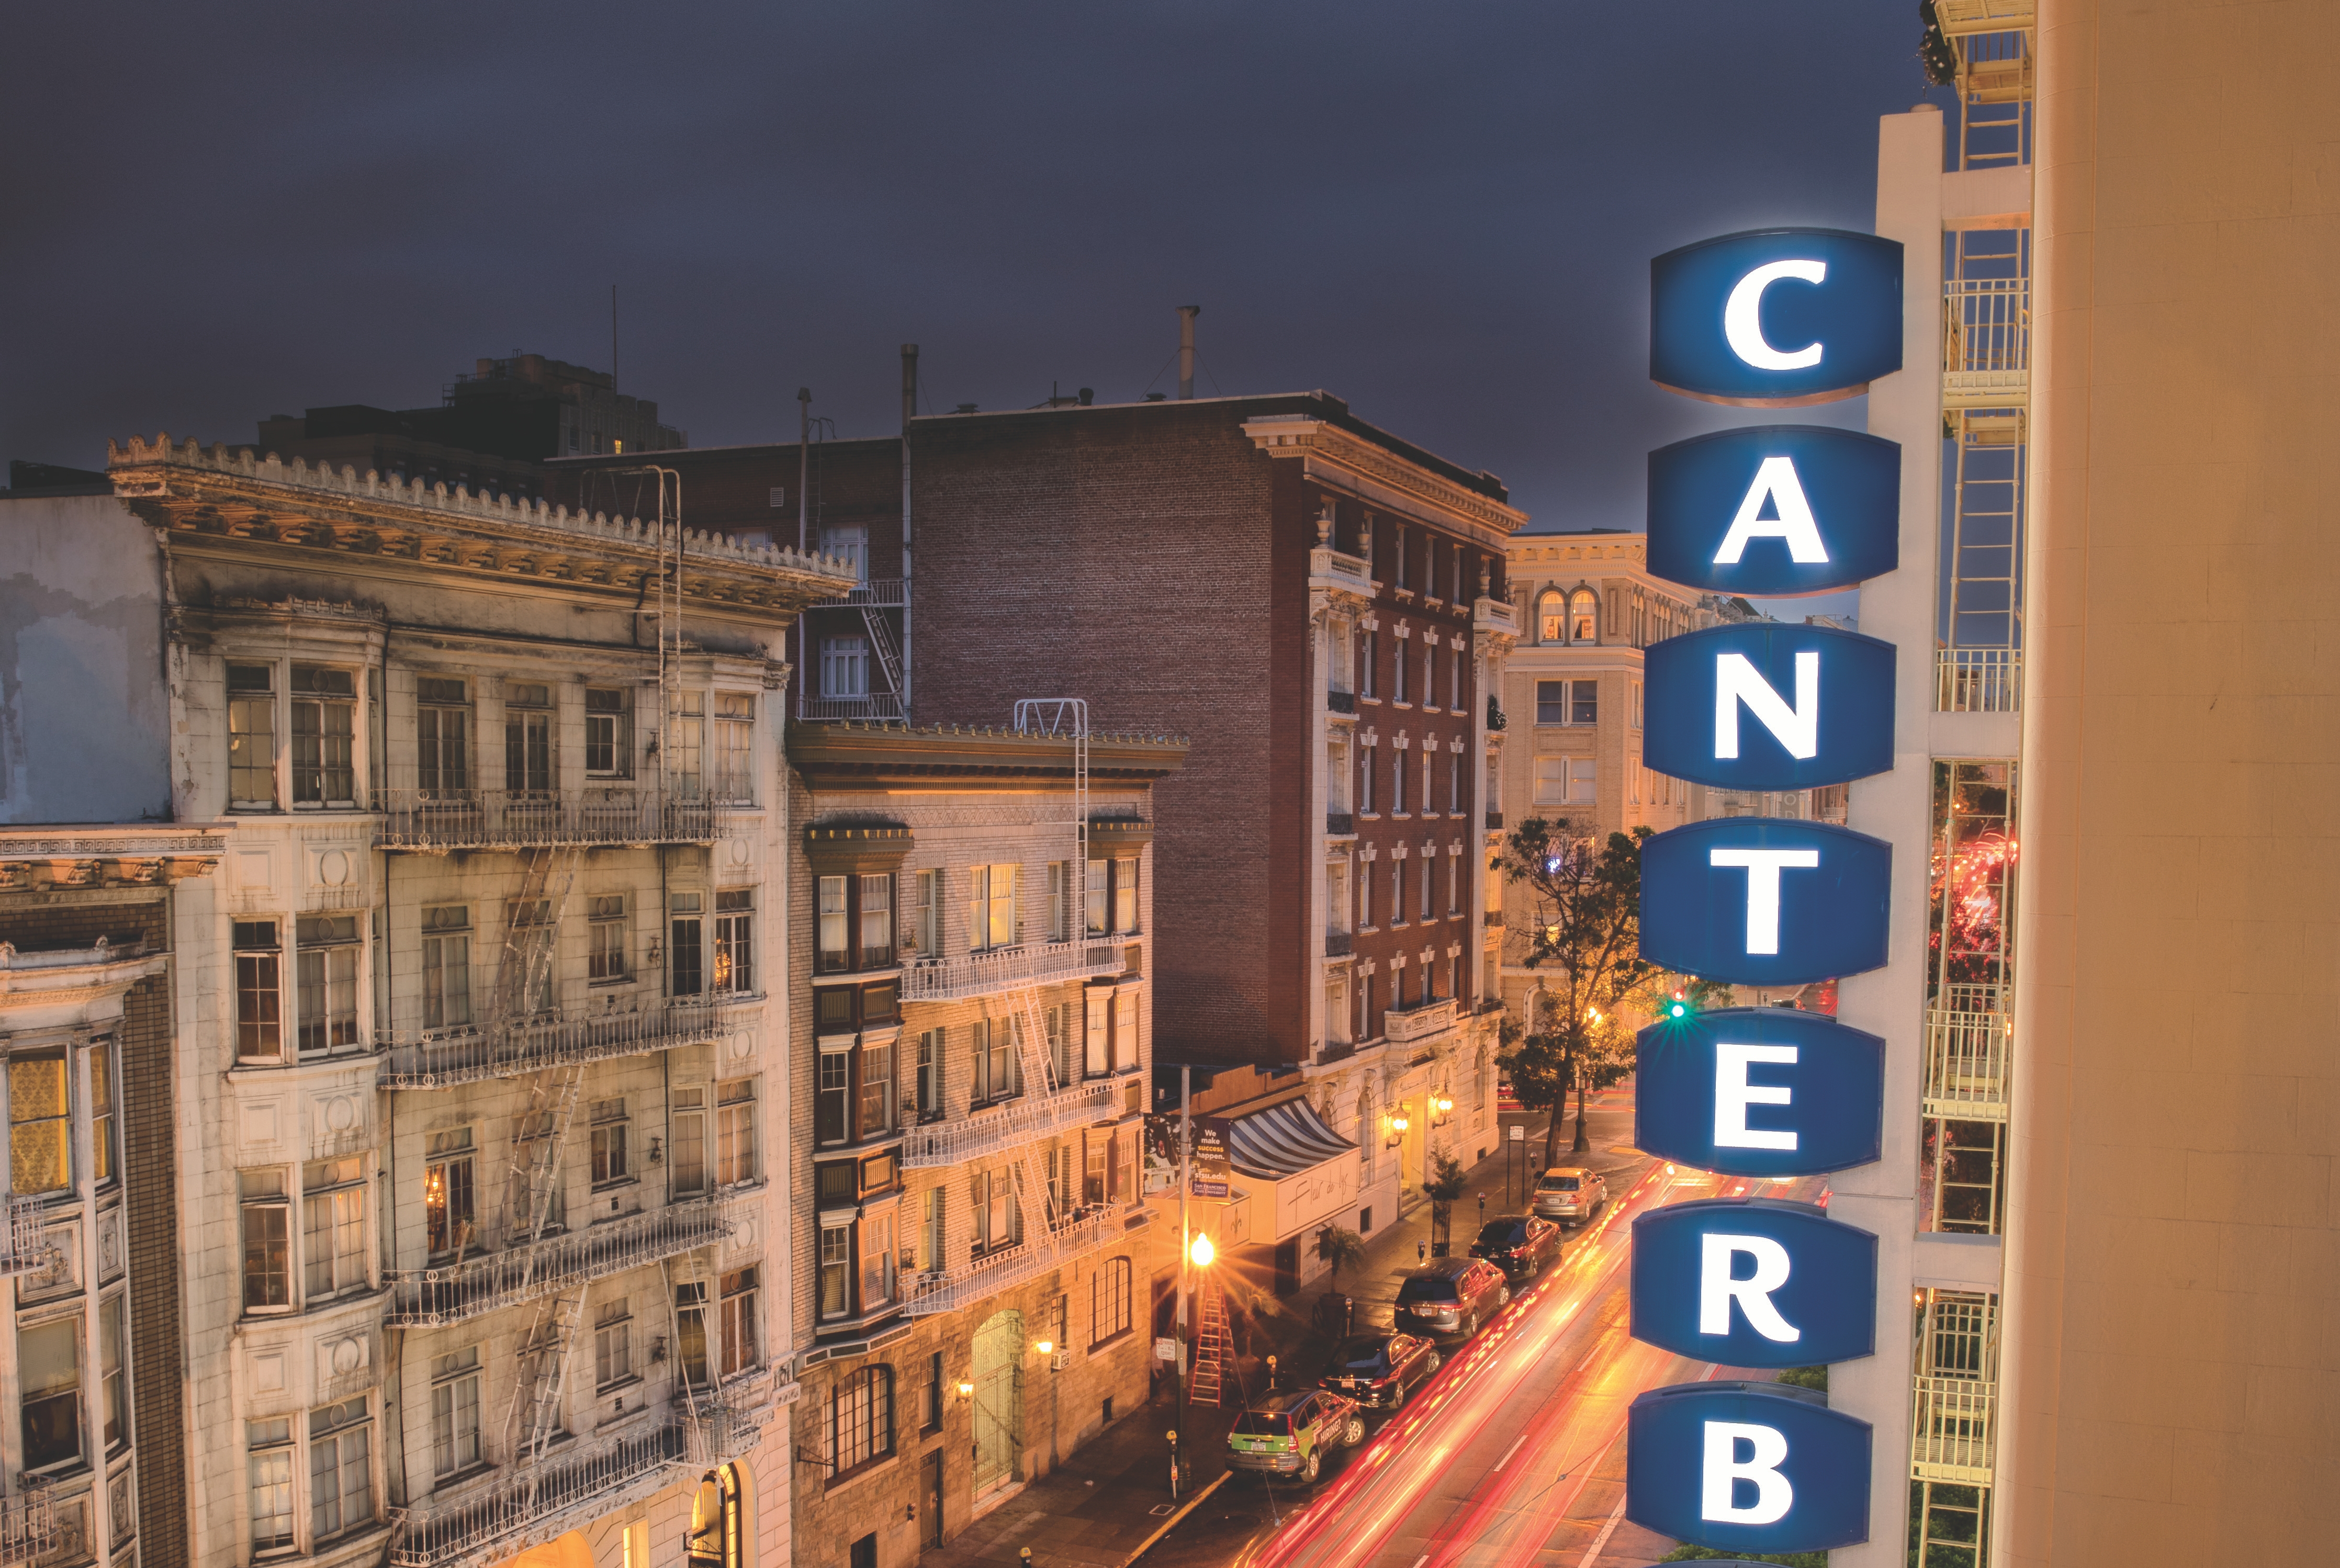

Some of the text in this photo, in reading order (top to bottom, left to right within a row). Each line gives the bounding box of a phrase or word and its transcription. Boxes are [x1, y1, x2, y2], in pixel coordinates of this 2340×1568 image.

[1196, 1150, 1225, 1160] happen.
[1195, 1170, 1226, 1180] sfsu.edu
[1327, 1169, 1335, 1194] de
[1320, 1418, 1341, 1444] HIRING?
